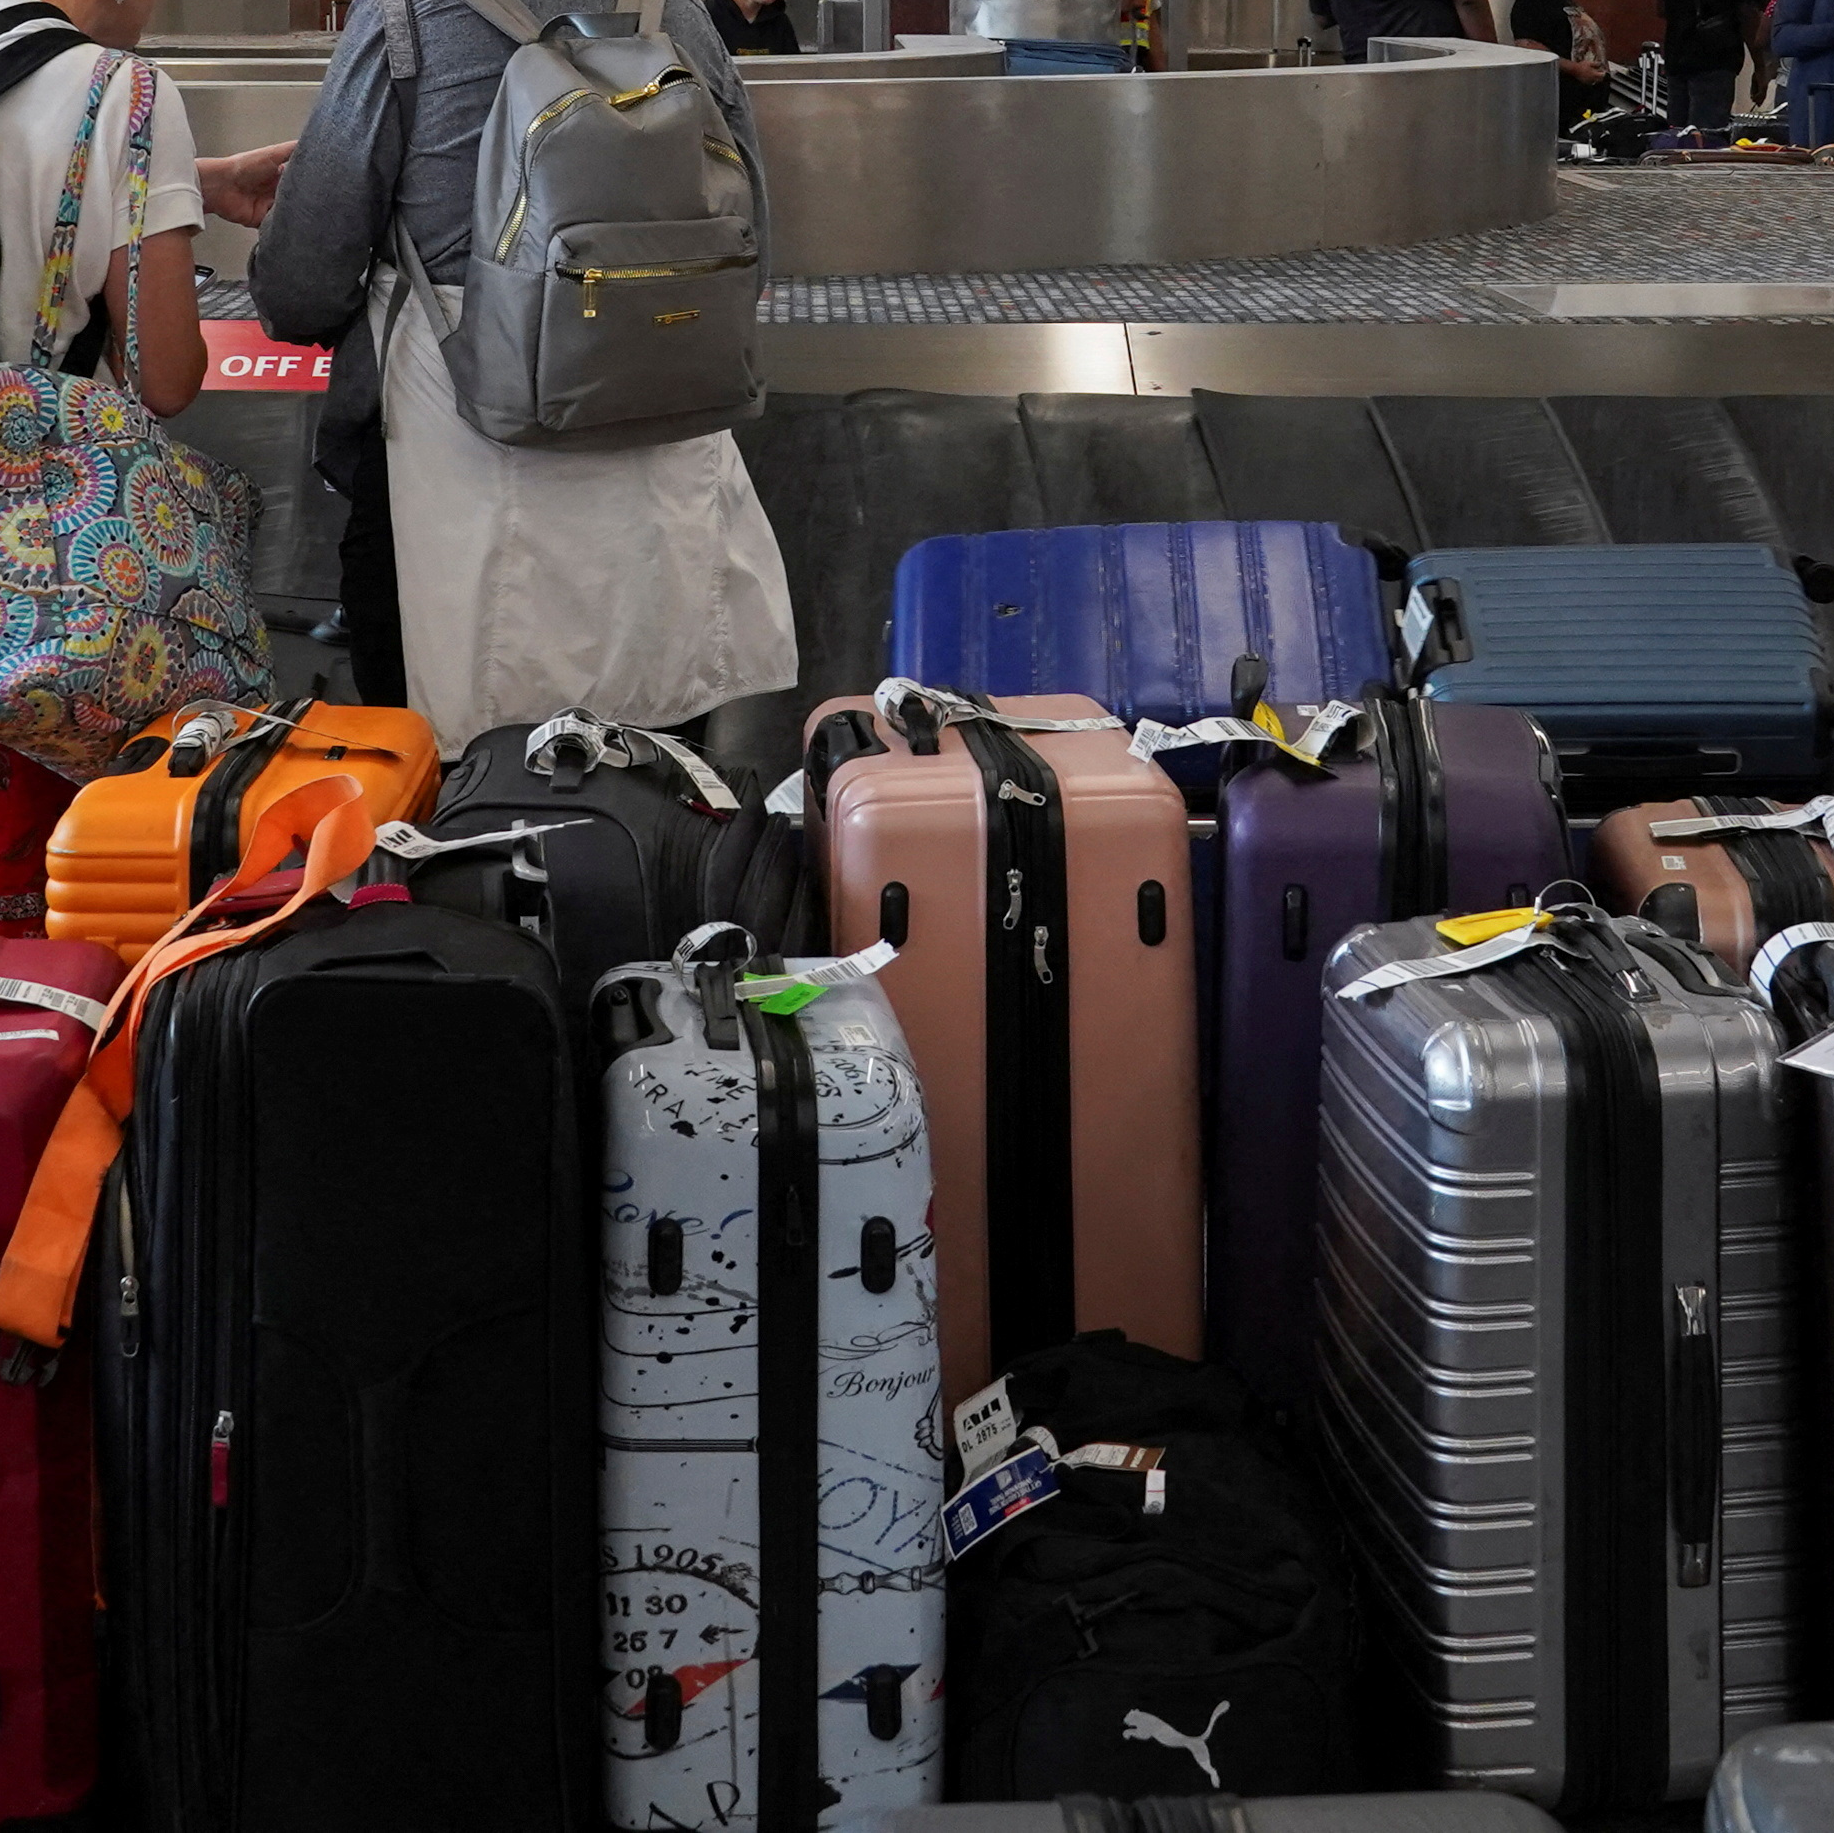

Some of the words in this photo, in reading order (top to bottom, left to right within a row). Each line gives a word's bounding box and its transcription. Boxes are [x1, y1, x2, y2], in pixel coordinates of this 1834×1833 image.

[219, 355, 303, 377] OFF
[826, 1365, 936, 1402] Bonjour
[962, 1397, 1002, 1432] ATL
[961, 1439, 974, 1454] DL
[975, 1424, 999, 1446] 2875
[634, 1543, 725, 1574] 1905
[644, 1593, 688, 1615] 30
[659, 1628, 679, 1650] 7
